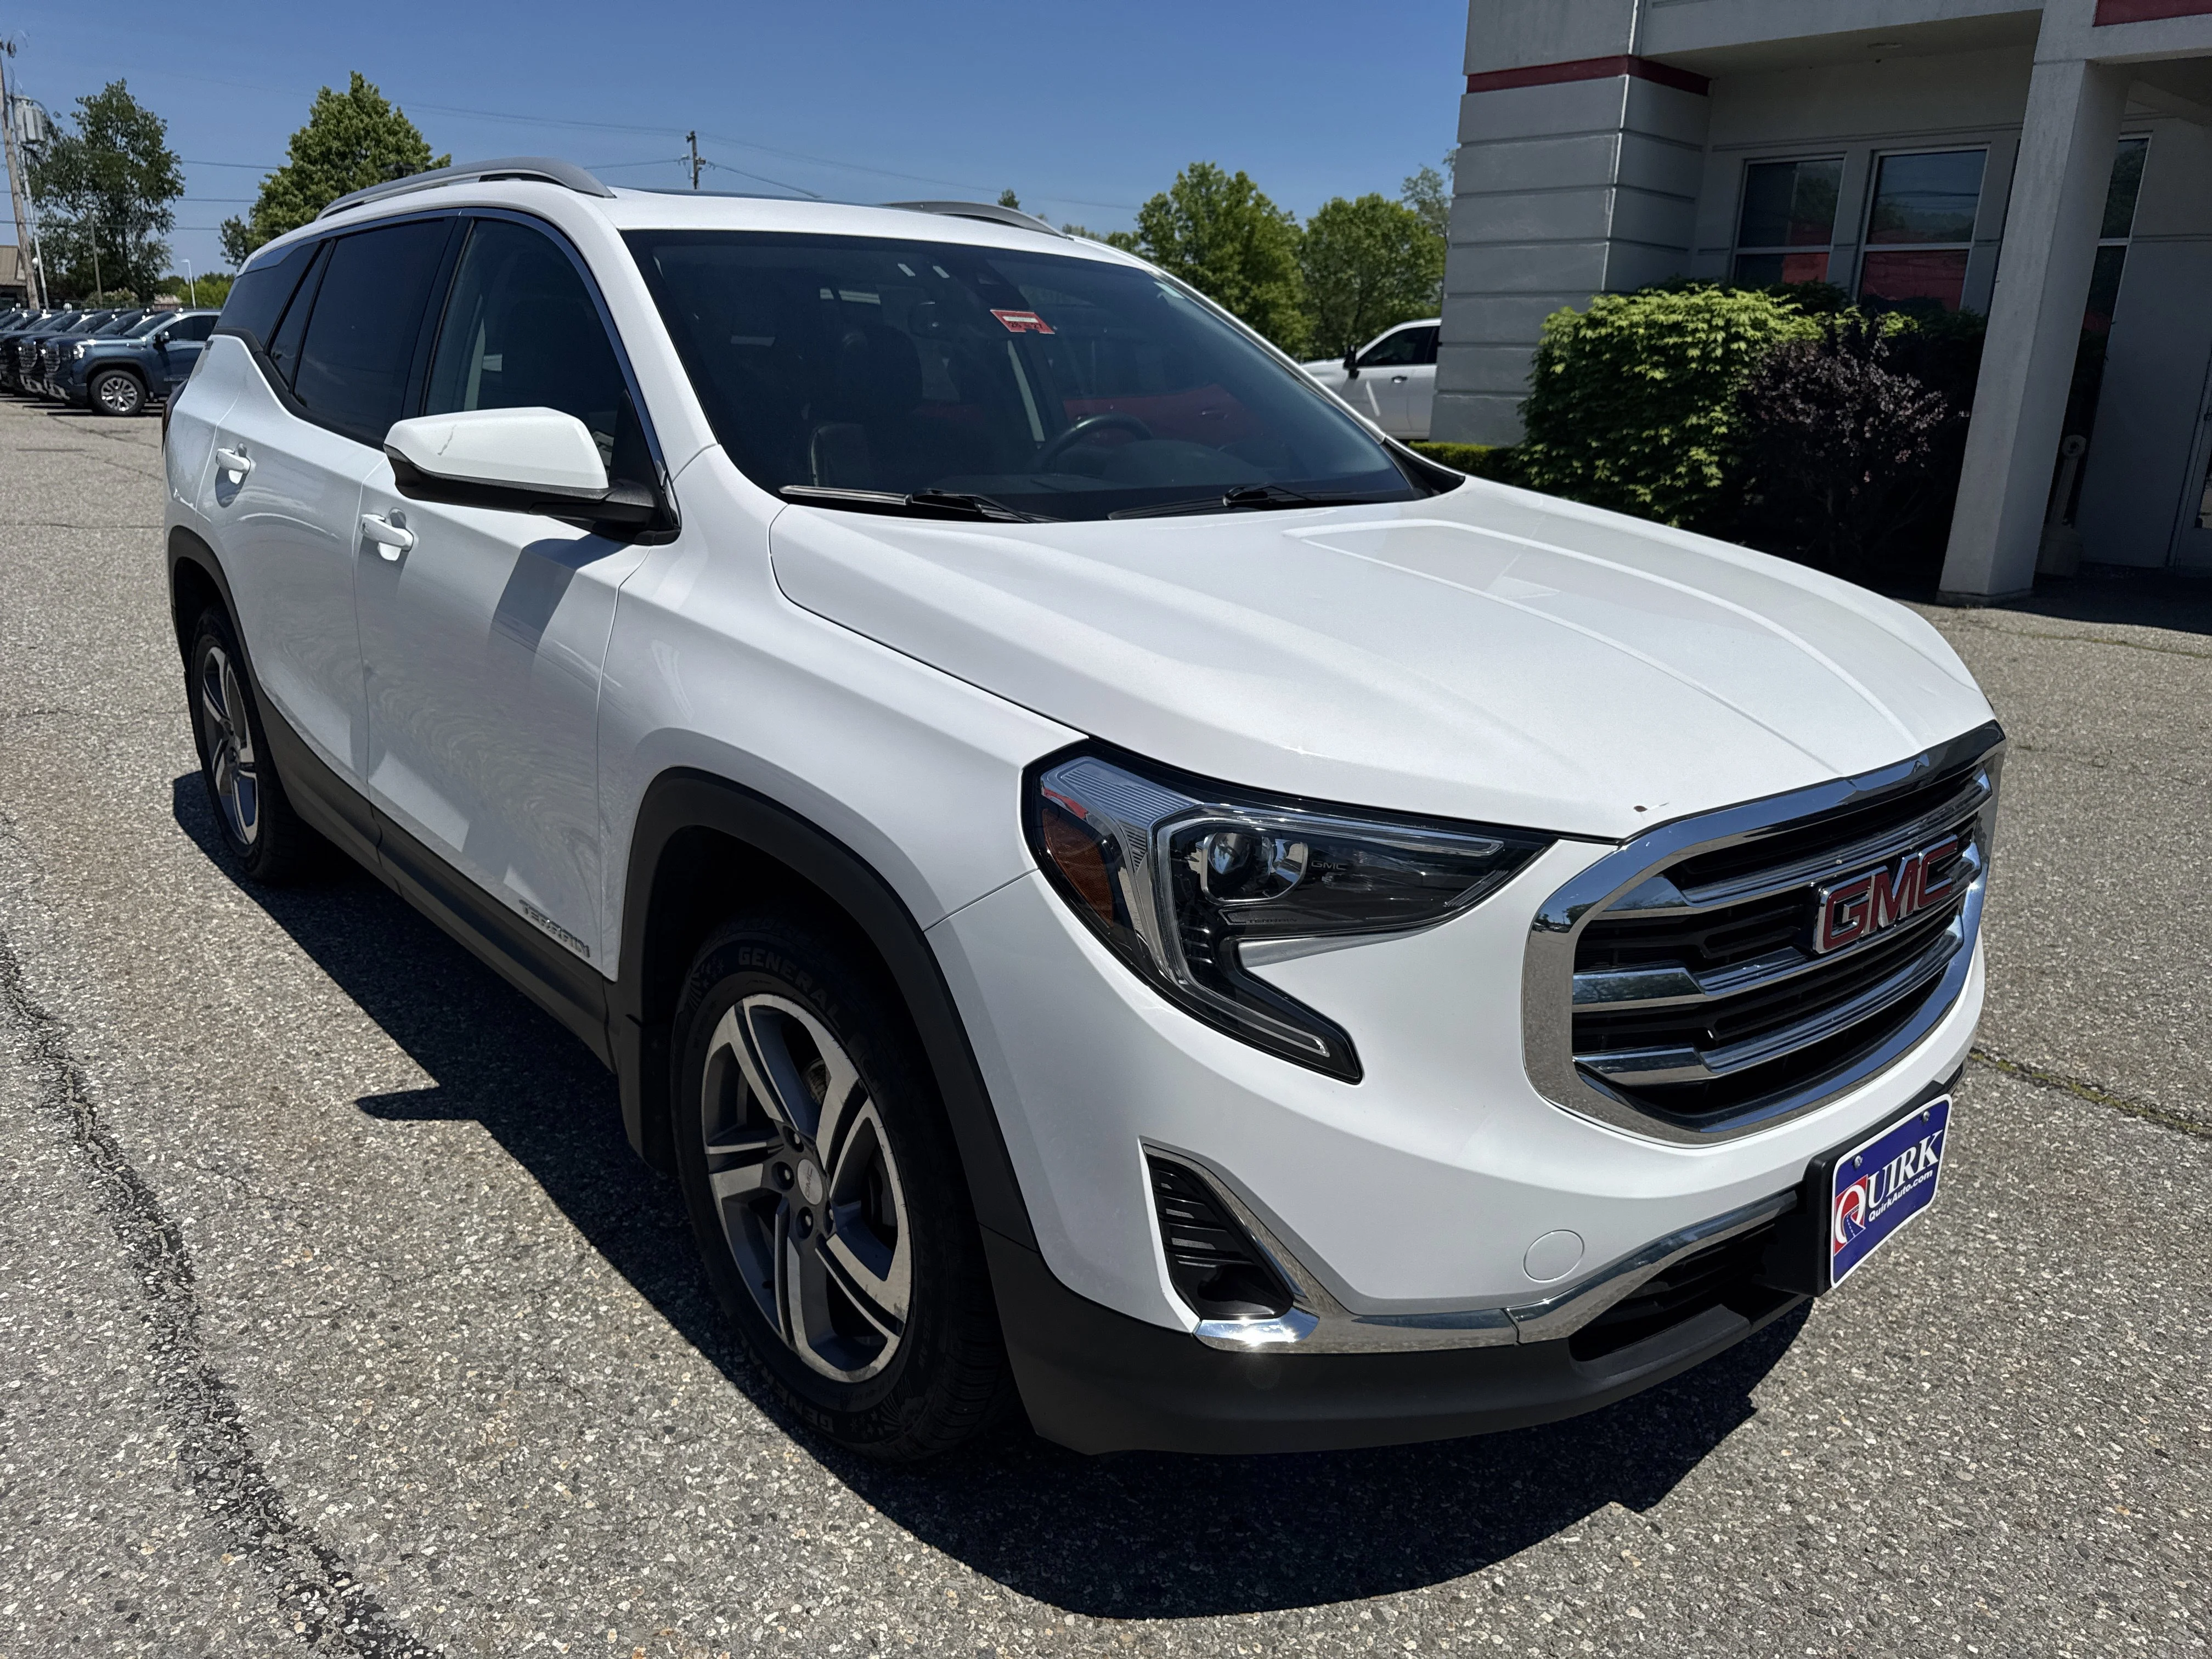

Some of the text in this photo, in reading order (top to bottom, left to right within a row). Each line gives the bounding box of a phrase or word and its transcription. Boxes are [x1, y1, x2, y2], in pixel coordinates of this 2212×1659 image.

[1311, 860, 1347, 871] GMC
[1813, 834, 1958, 955] GMC
[738, 946, 841, 1030] GENERAL
[1835, 1129, 1943, 1244] QUIRK
[1868, 1169, 1933, 1222] QuirkAuto.com
